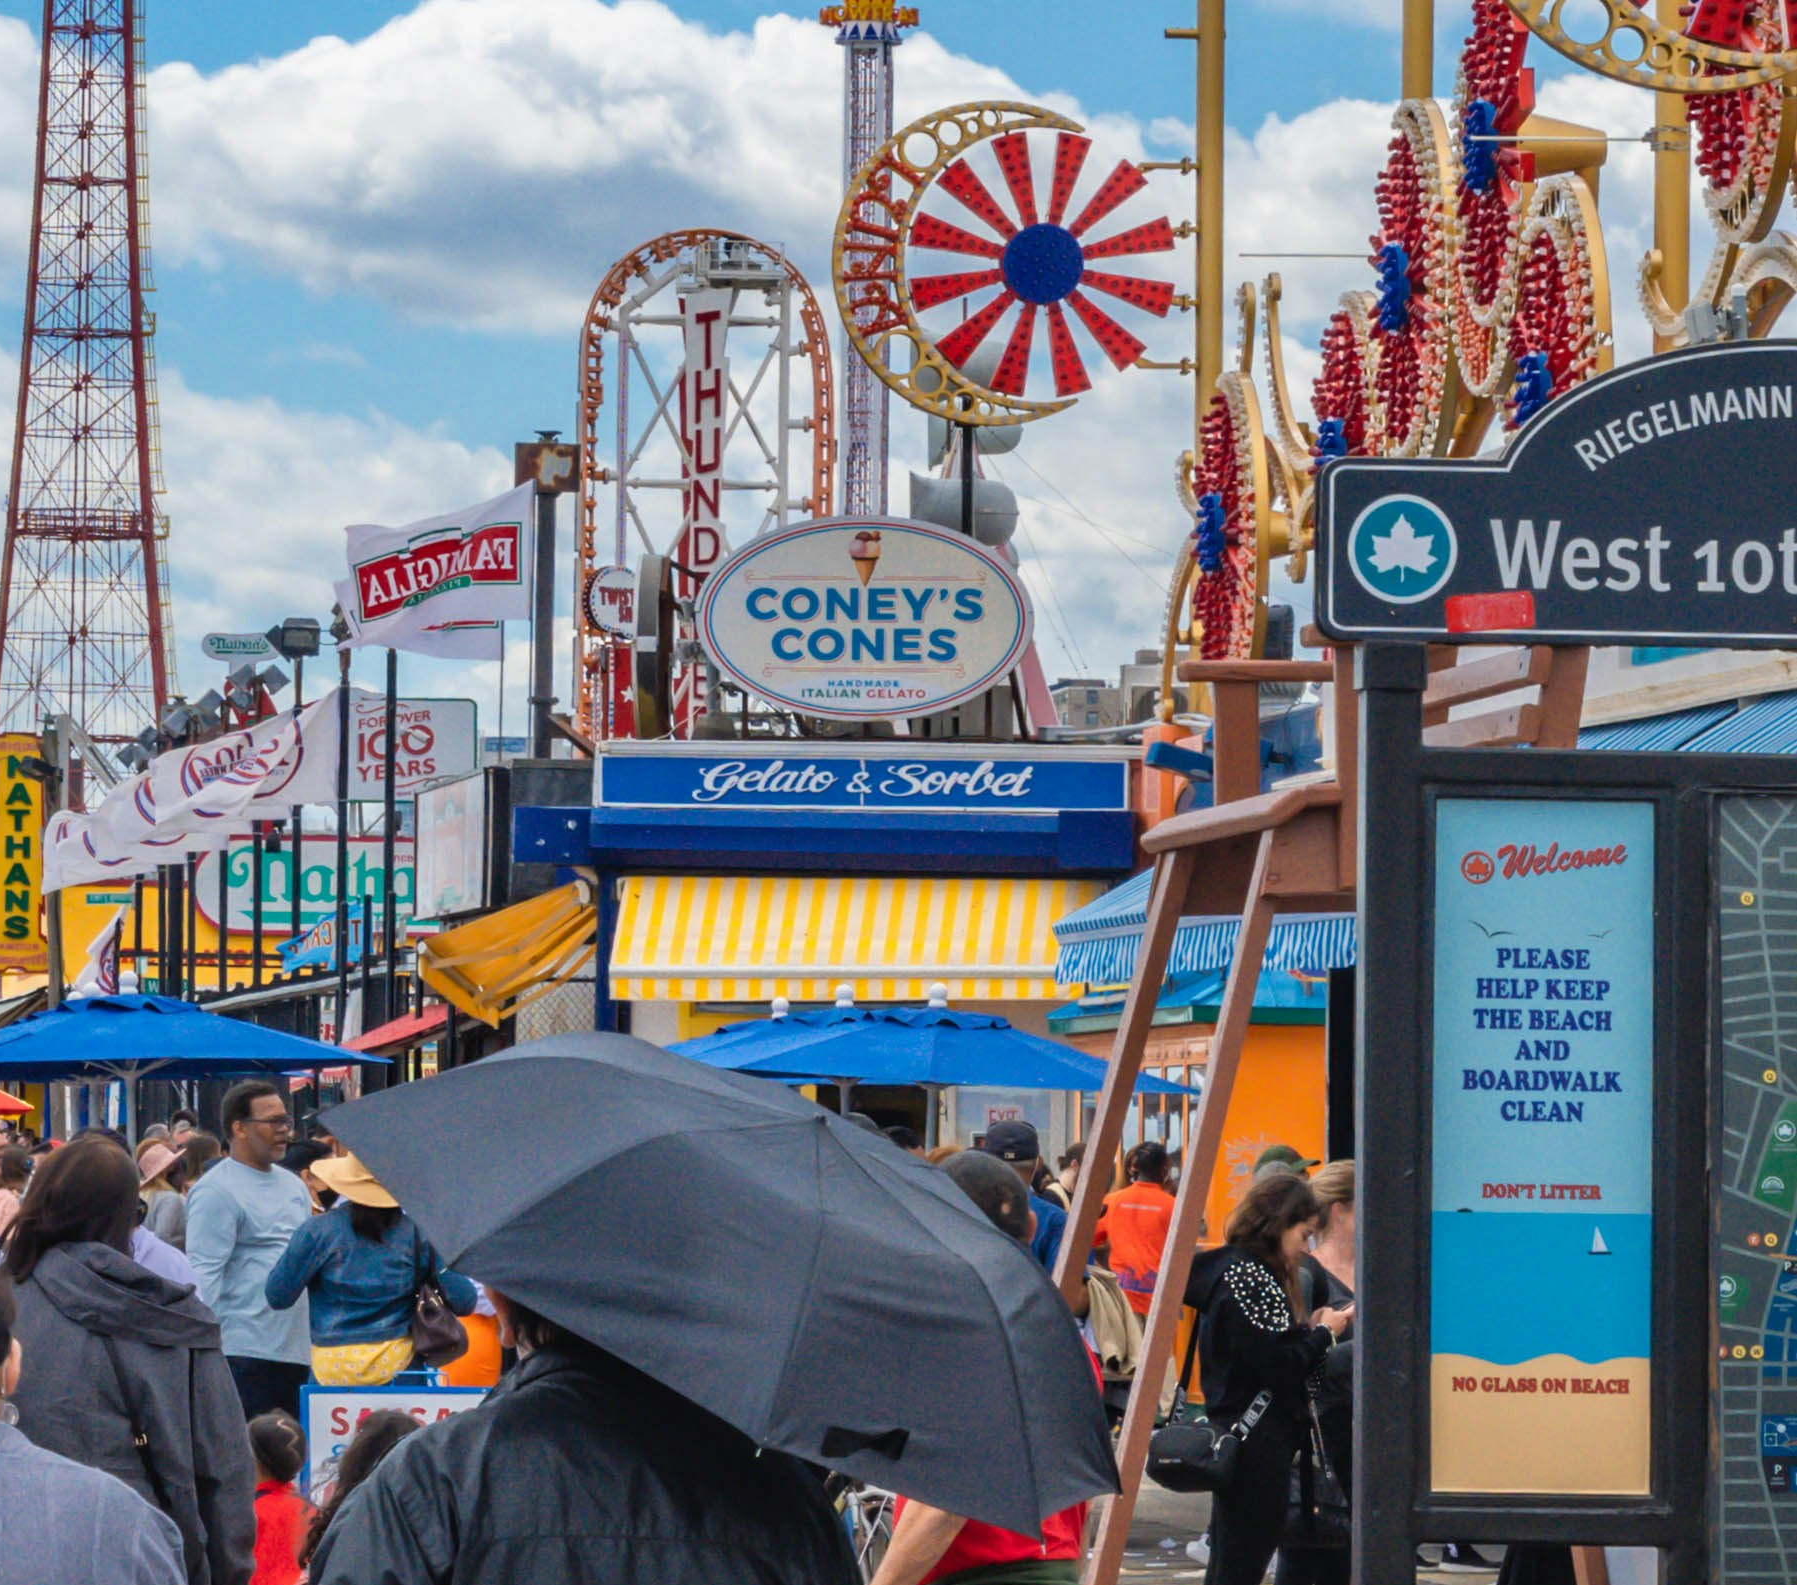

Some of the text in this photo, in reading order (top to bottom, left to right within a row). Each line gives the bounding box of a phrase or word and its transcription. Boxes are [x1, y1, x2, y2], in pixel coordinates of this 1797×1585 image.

[1573, 384, 1793, 472] RIEGELMANN
[1489, 518, 1672, 592] West
[745, 586, 986, 623] CONEY'S
[771, 627, 960, 663] CONES
[800, 688, 927, 699] ITALIAN GELATO
[827, 679, 901, 689] HANDMADE
[356, 757, 436, 783] YEARS
[691, 760, 1035, 802] Gelato & Sorbet
[2, 754, 33, 940] NATHANS
[1496, 841, 1629, 879] Welcome
[1496, 947, 1591, 970] PLEASE
[1475, 978, 1611, 1002] HELP KEEP
[1472, 1008, 1613, 1032] THE BEACH
[1514, 1039, 1571, 1062] AND
[1461, 1069, 1623, 1093] BOARDWALK
[1500, 1100, 1585, 1123] CLEAN
[1481, 1182, 1603, 1201] DON'T LITTER
[1451, 1376, 1630, 1395] NO GLASS ON BEACH
